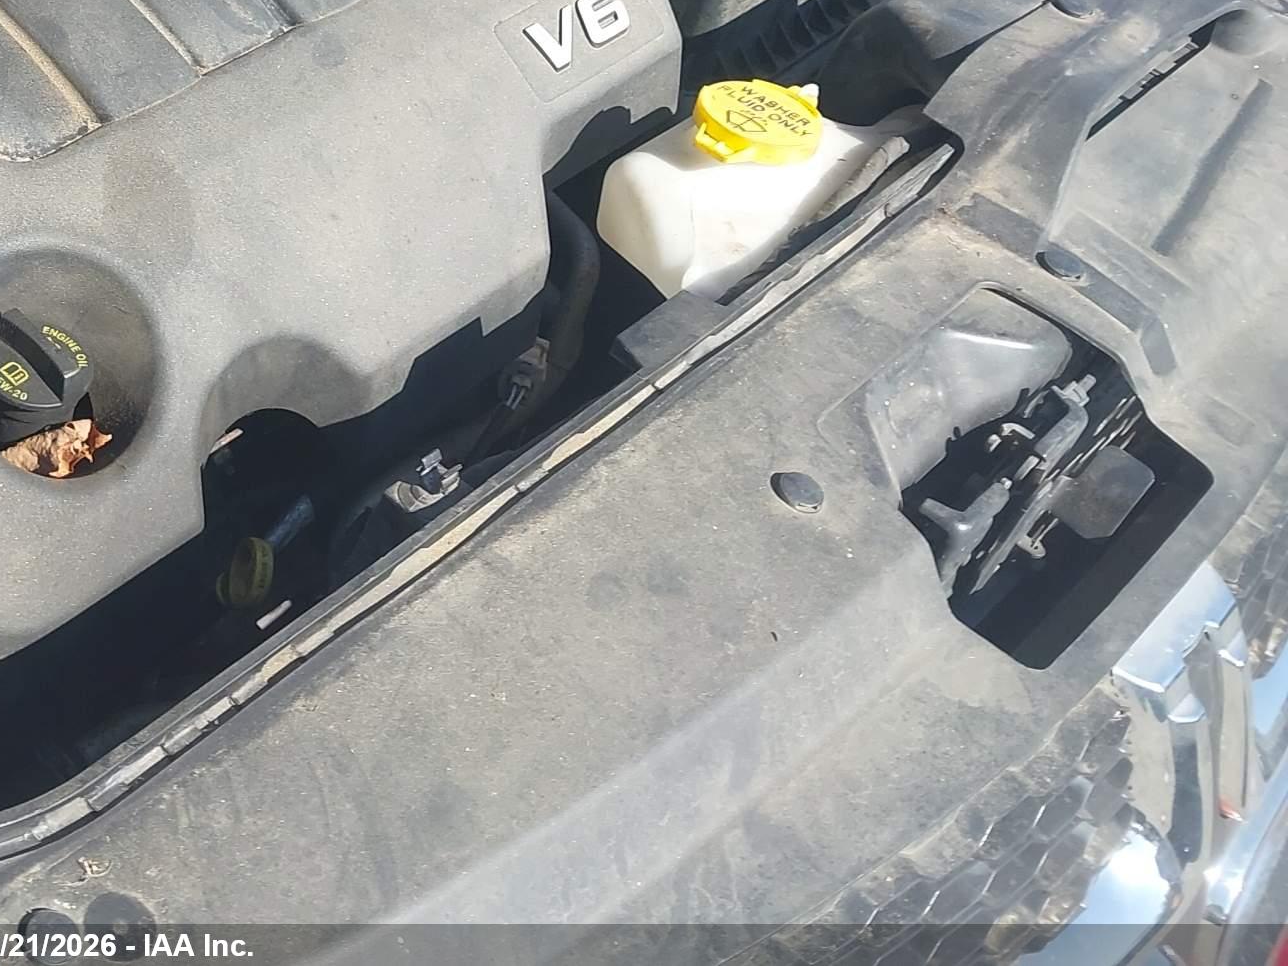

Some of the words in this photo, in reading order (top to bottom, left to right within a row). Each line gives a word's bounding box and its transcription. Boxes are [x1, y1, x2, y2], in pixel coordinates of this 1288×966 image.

[717, 85, 766, 112] FLUID
[767, 113, 813, 136] ONLY
[741, 86, 811, 126] WASHER
[41, 325, 82, 353] ENGINE
[75, 353, 89, 367] OIL
